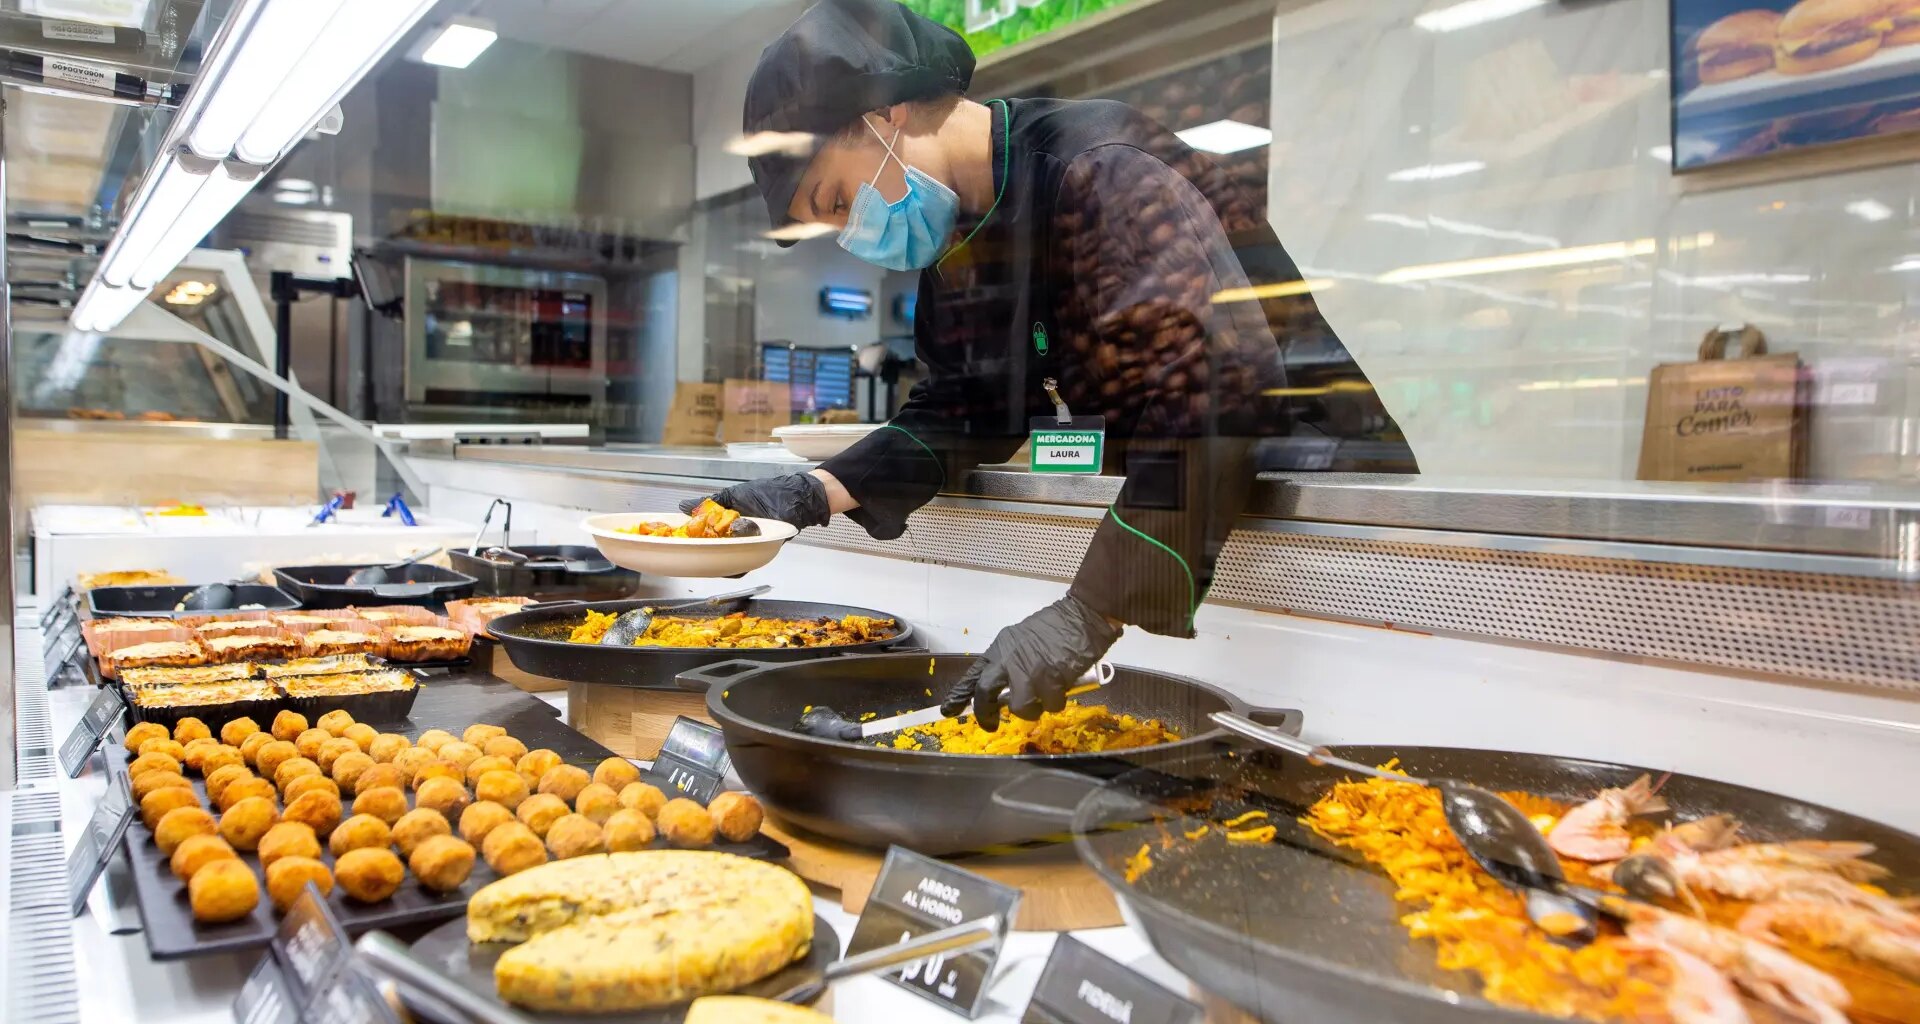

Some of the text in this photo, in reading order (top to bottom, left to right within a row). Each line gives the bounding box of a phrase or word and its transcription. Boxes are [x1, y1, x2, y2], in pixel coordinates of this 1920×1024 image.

[1696, 386, 1744, 401] LISTO
[1694, 400, 1740, 413] PARA
[1676, 409, 1757, 437] Comer
[1036, 434, 1096, 443] MERCADONA
[1050, 450, 1080, 458] LAURA
[918, 877, 960, 905] ARROZ
[902, 890, 963, 924] AL HORNO
